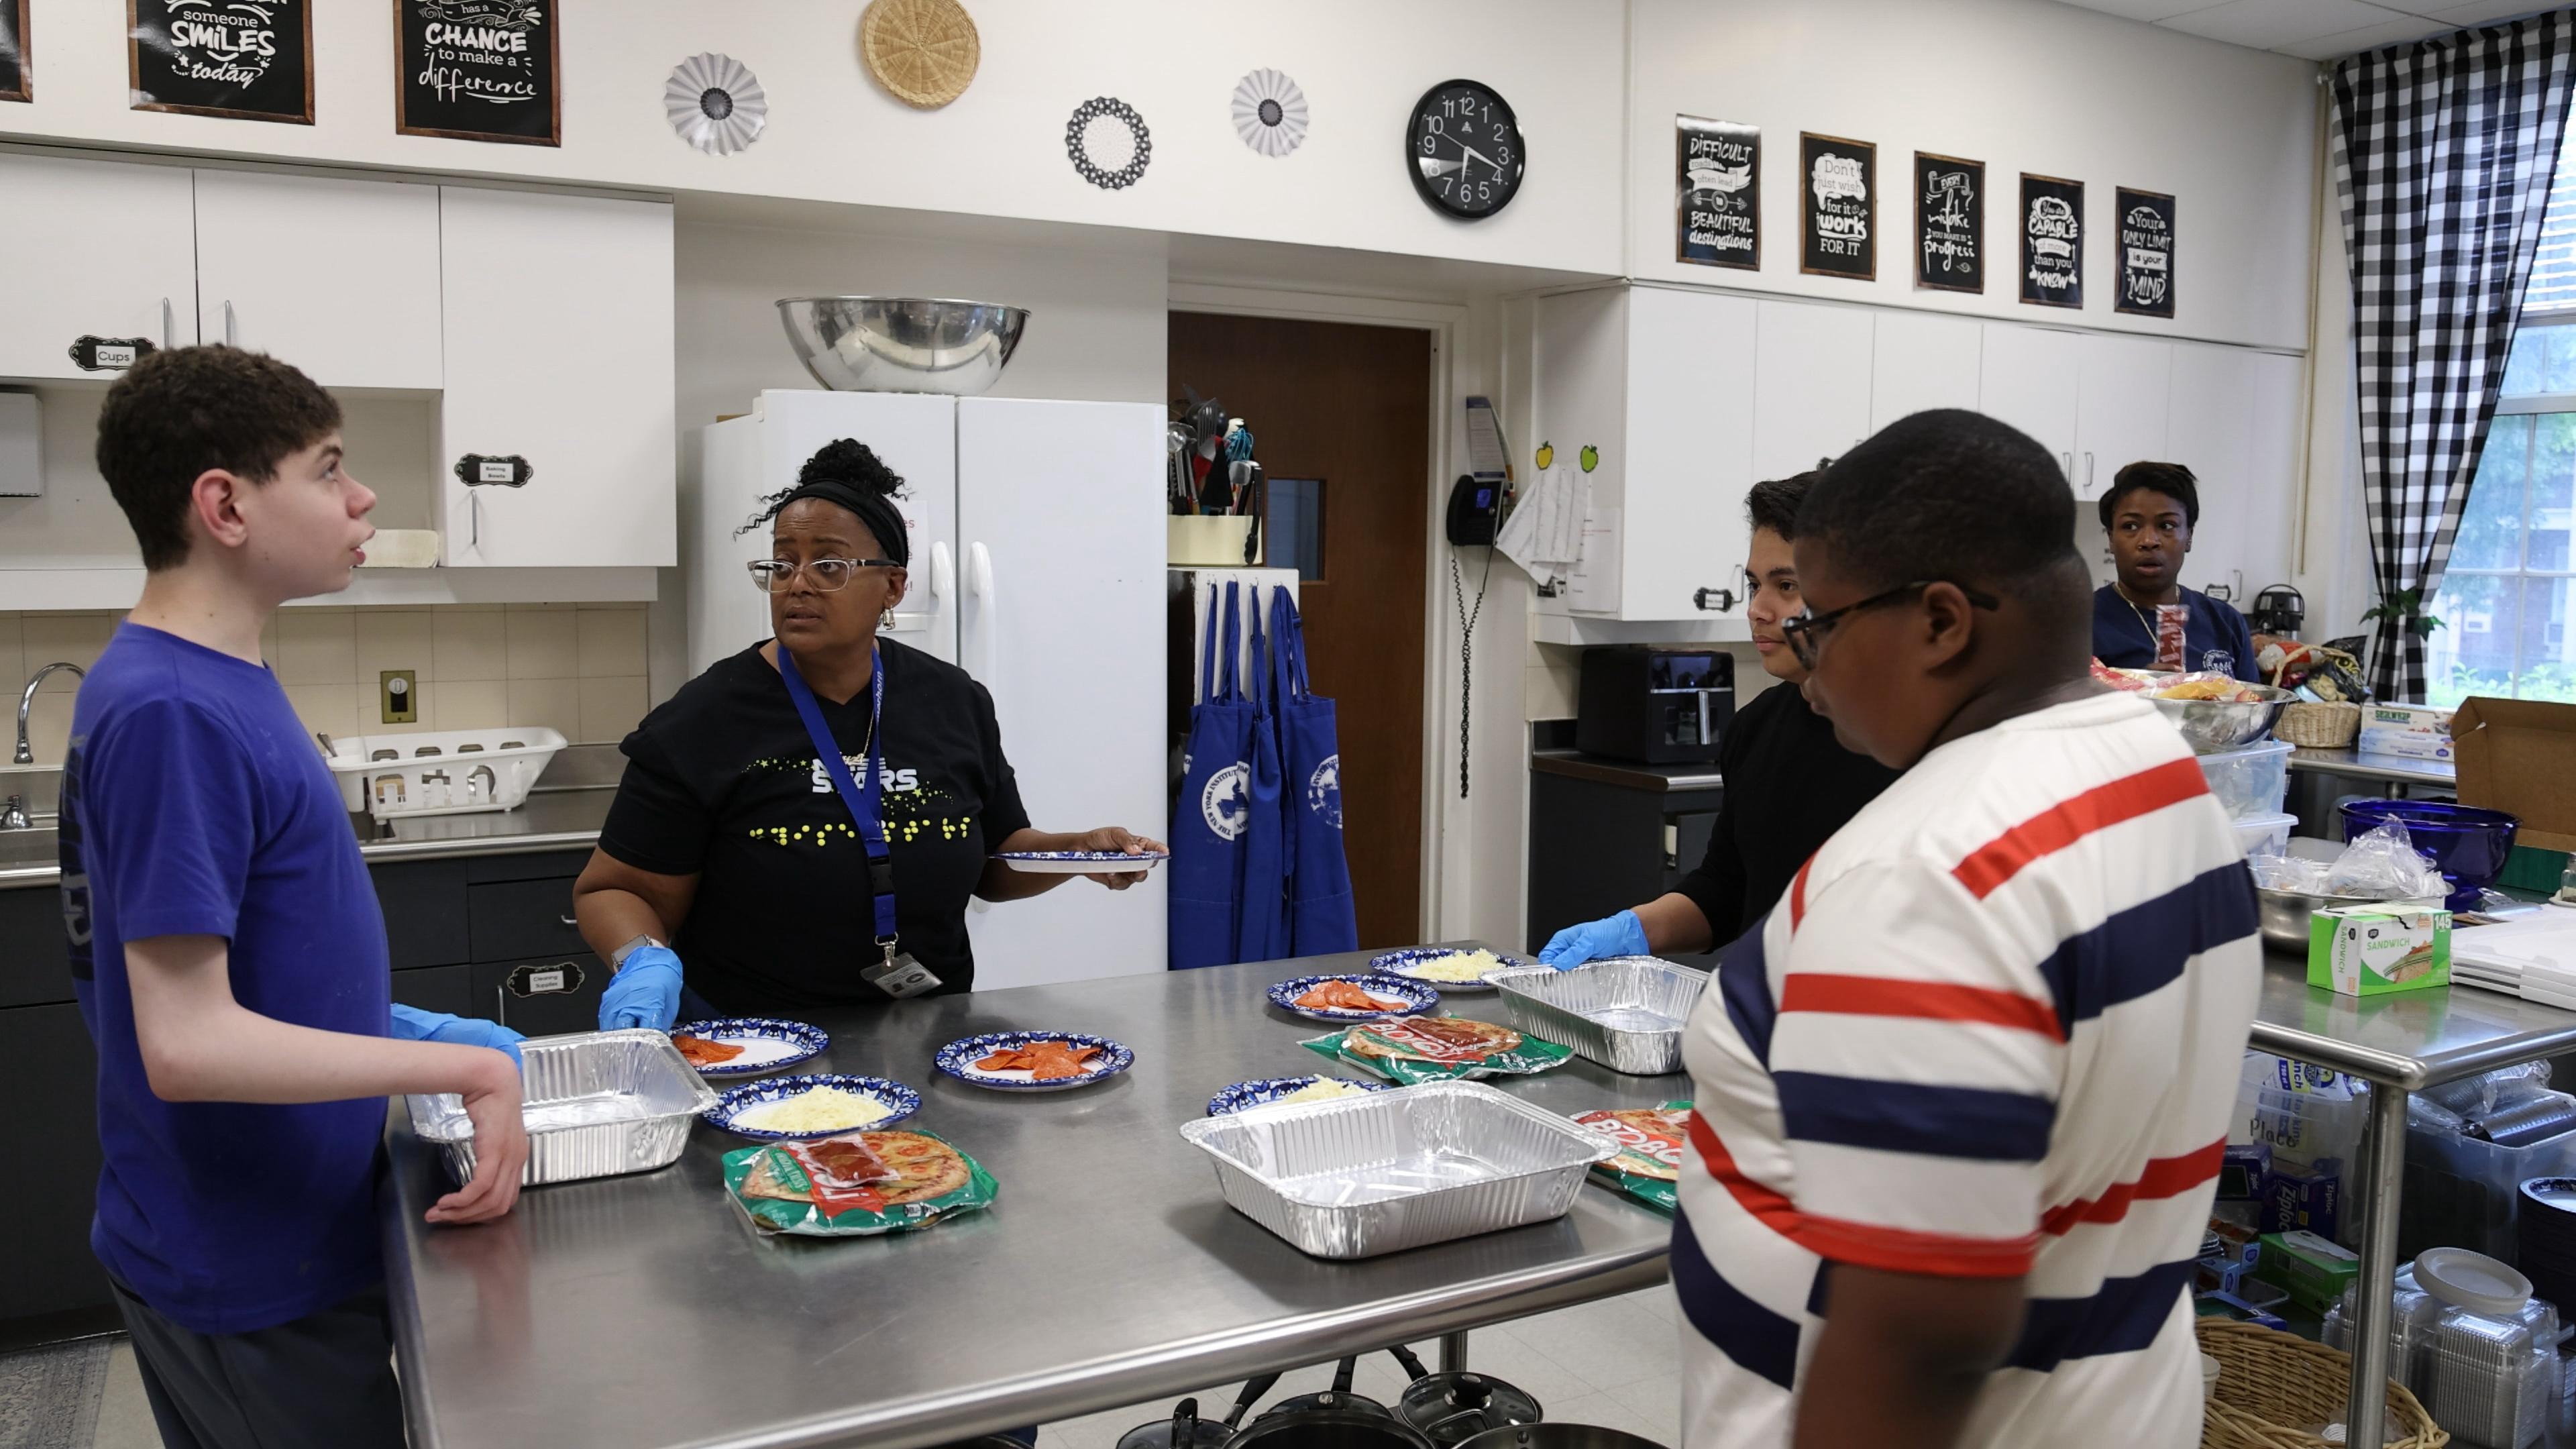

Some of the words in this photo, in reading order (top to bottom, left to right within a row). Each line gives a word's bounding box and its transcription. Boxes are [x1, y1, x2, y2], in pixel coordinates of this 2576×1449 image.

[462, 5, 480, 14] has
[183, 11, 258, 28] someone
[425, 22, 527, 53] CHANCE
[439, 48, 454, 60] to
[460, 50, 503, 64] make
[508, 57, 517, 66] a
[191, 62, 264, 89] today
[419, 52, 537, 103] difference
[1442, 99, 1454, 118] 11
[1458, 97, 1475, 115] 12
[1481, 105, 1488, 123] 1
[1426, 115, 1444, 134] 10
[1493, 123, 1504, 142] 2
[1424, 136, 1436, 154] 9
[1497, 146, 1509, 165] 3
[1429, 158, 1440, 176] 8
[1824, 160, 1855, 177] Don't
[1492, 168, 1503, 185] 4
[1697, 174, 1716, 184] often
[1718, 176, 1733, 187] lead
[1817, 175, 1836, 190] just
[1838, 180, 1862, 193] wish
[1443, 177, 1454, 195] 7
[1460, 184, 1471, 203] 6
[1479, 181, 1490, 200] 5
[1827, 199, 1841, 213] for
[1843, 202, 1851, 215] it
[2029, 217, 2078, 239] CAPABLE
[2135, 213, 2158, 229] Your
[1688, 229, 1753, 251] destinations
[1932, 230, 1943, 239] YOU
[2123, 229, 2146, 248] ONLY
[1820, 237, 1844, 254] FOR
[1847, 241, 1860, 256] IT
[2039, 241, 2045, 249] of
[2047, 242, 2066, 252] more
[1924, 241, 1975, 274] progress
[2034, 255, 2054, 266] than
[2055, 257, 2072, 270] you
[2133, 253, 2141, 262] is
[2143, 256, 2162, 265] your
[2037, 271, 2068, 289] KNOW
[98, 352, 129, 363] Cups
[812, 769, 918, 794] SARS
[1210, 769, 1237, 792] INSTITUT
[1205, 790, 1214, 810] YORK
[1208, 811, 1219, 826] NEW
[2434, 914, 2451, 930] 145
[2339, 926, 2347, 974] SANDWICH
[2367, 938, 2410, 951] SANDWICH
[2250, 1118, 2297, 1148] Place
[2277, 1185, 2297, 1232] Ziploc
[2325, 1184, 2334, 1215] Ziploc
